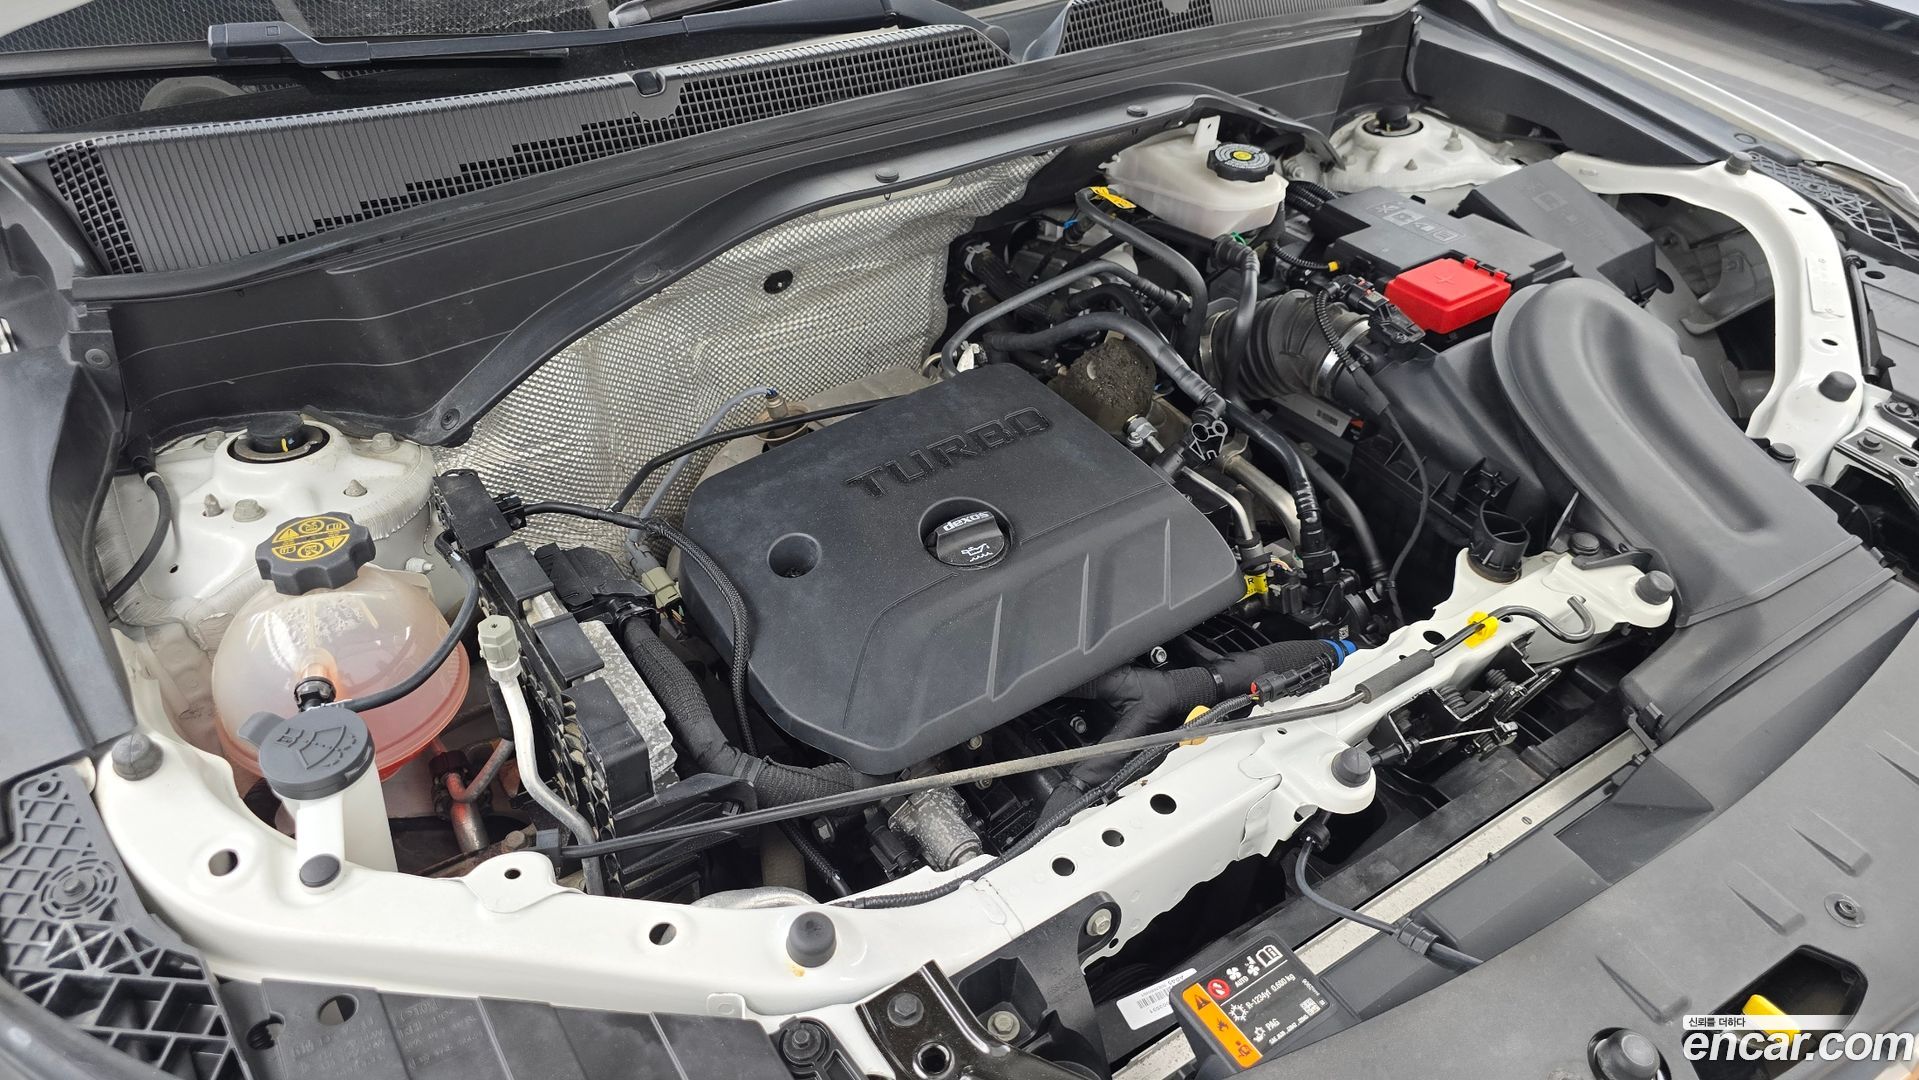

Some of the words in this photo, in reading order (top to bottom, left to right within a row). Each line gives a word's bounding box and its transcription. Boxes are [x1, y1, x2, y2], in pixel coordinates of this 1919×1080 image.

[845, 406, 1050, 497] TURBO
[943, 511, 991, 532] dexos
[1234, 975, 1249, 988] AUTO
[1285, 973, 1296, 982] kg
[1265, 1018, 1280, 1031] PAG
